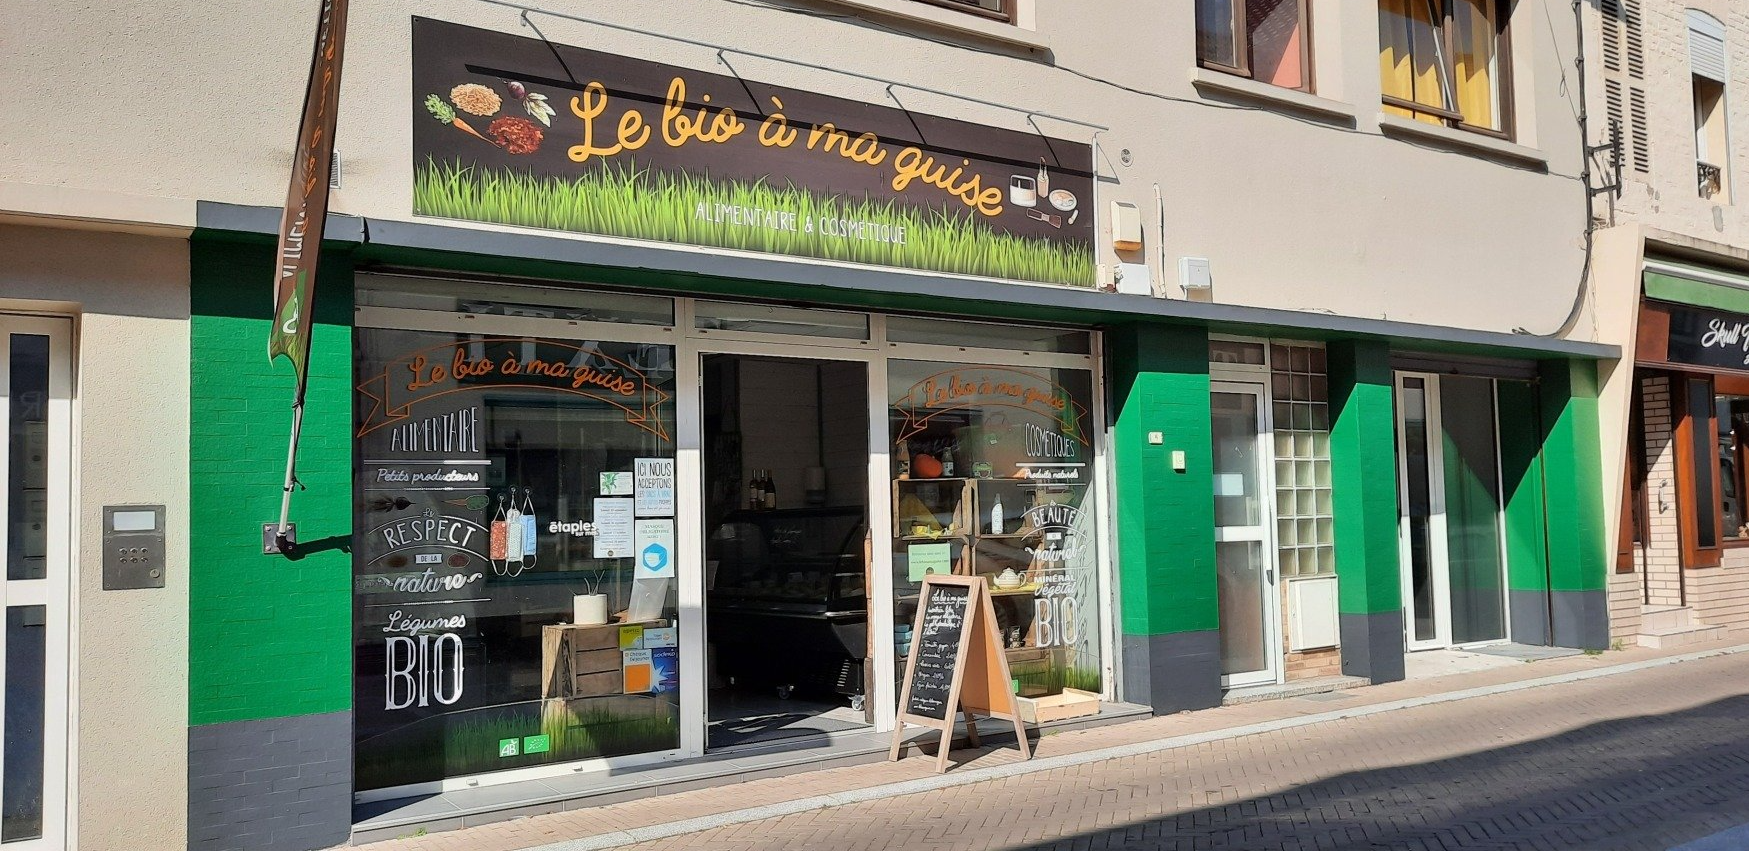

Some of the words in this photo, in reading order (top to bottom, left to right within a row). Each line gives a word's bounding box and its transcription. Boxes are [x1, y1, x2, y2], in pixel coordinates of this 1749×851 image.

[568, 82, 651, 162] Le
[662, 77, 745, 147] bio
[758, 96, 798, 147] à
[807, 123, 887, 166] ma
[892, 147, 1003, 216] guise
[695, 201, 797, 232] ALIMENTAIRE
[804, 216, 814, 233] &
[1701, 319, 1742, 348] Skull
[407, 354, 448, 391] Le
[452, 348, 495, 379] bio
[501, 351, 521, 374] à
[527, 359, 570, 378] ma
[572, 367, 635, 396] guise
[391, 407, 479, 452] ALIMENTAIRE
[1025, 422, 1075, 457] COSMÉTIQUES
[376, 468, 409, 483] Petits
[411, 468, 480, 484] producteurs
[638, 462, 646, 477] ICI
[650, 462, 671, 477] NOUS
[1024, 467, 1051, 479] Produits
[1052, 467, 1079, 479] naturels
[638, 478, 671, 489] ACCEPTONS
[423, 507, 434, 518] Le
[1031, 507, 1077, 528] BEAUTÉ
[383, 519, 476, 549] RESPECT
[393, 567, 467, 593] nature
[1034, 574, 1076, 583] MINÉRAL
[1034, 581, 1077, 601] Végétal
[383, 609, 466, 636] Légumes
[1034, 596, 1078, 648] BIO
[385, 632, 465, 711] BIO
